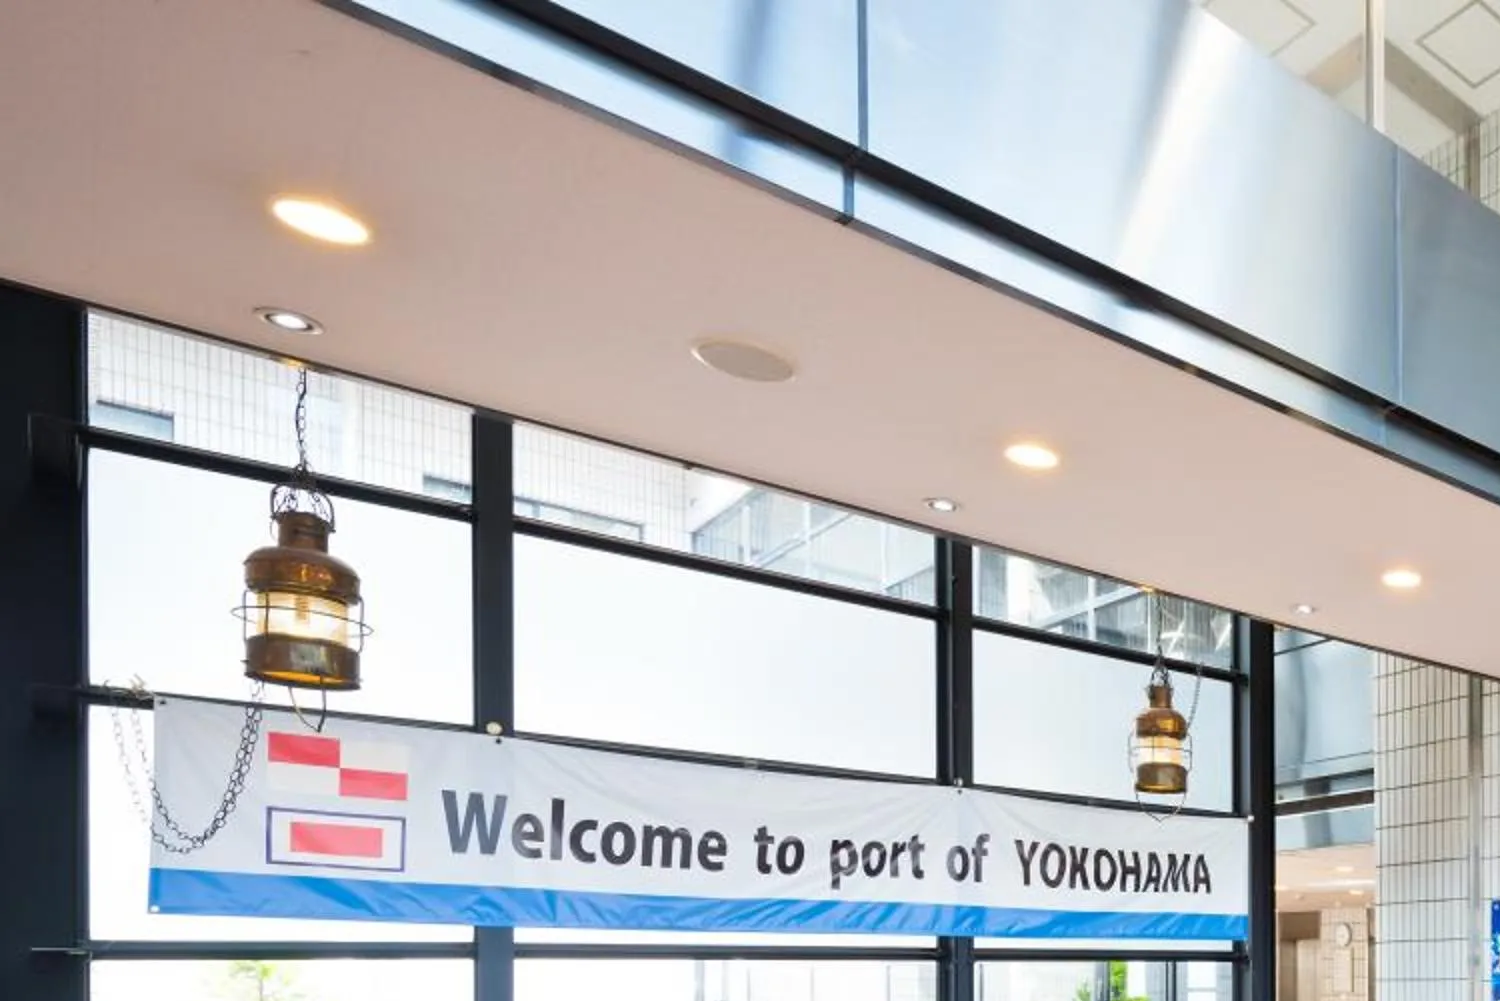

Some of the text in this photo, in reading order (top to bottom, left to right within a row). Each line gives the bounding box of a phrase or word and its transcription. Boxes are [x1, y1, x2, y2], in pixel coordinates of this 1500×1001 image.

[441, 789, 1212, 894] Welcome to port of YOKOHAMA
